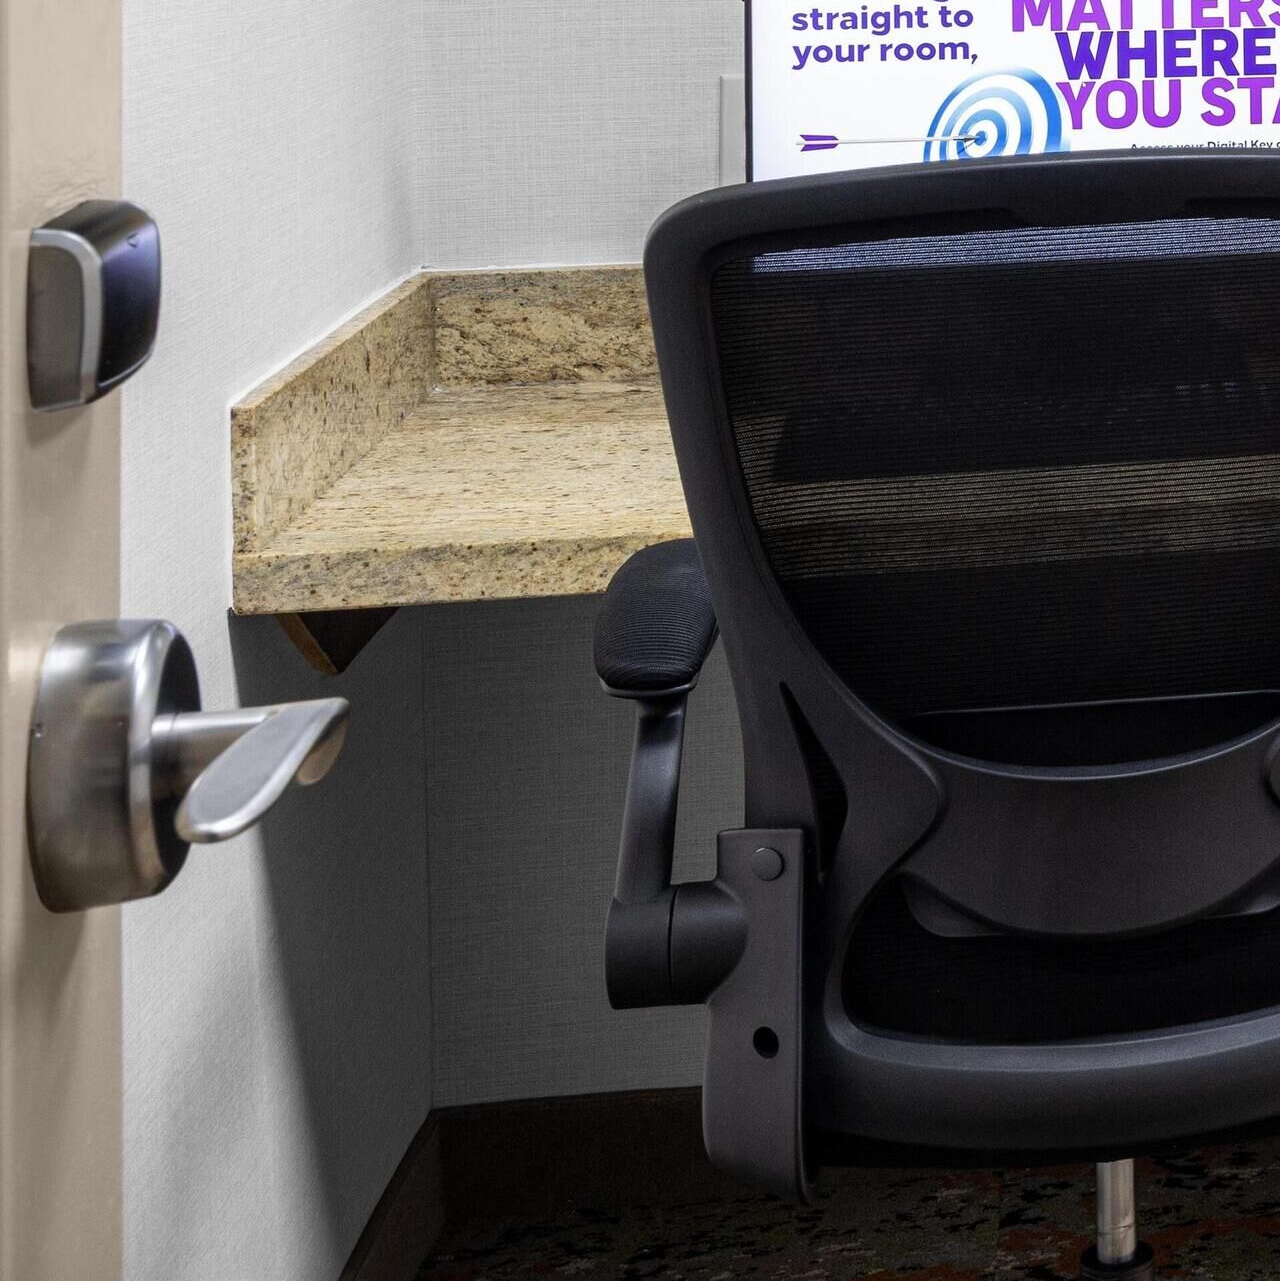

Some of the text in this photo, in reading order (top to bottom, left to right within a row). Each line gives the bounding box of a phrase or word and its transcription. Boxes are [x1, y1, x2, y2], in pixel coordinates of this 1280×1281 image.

[792, 4, 974, 36] straight to
[791, 41, 978, 71] your room,
[1055, 27, 1277, 80] WHERE
[1056, 79, 1181, 130] YOU
